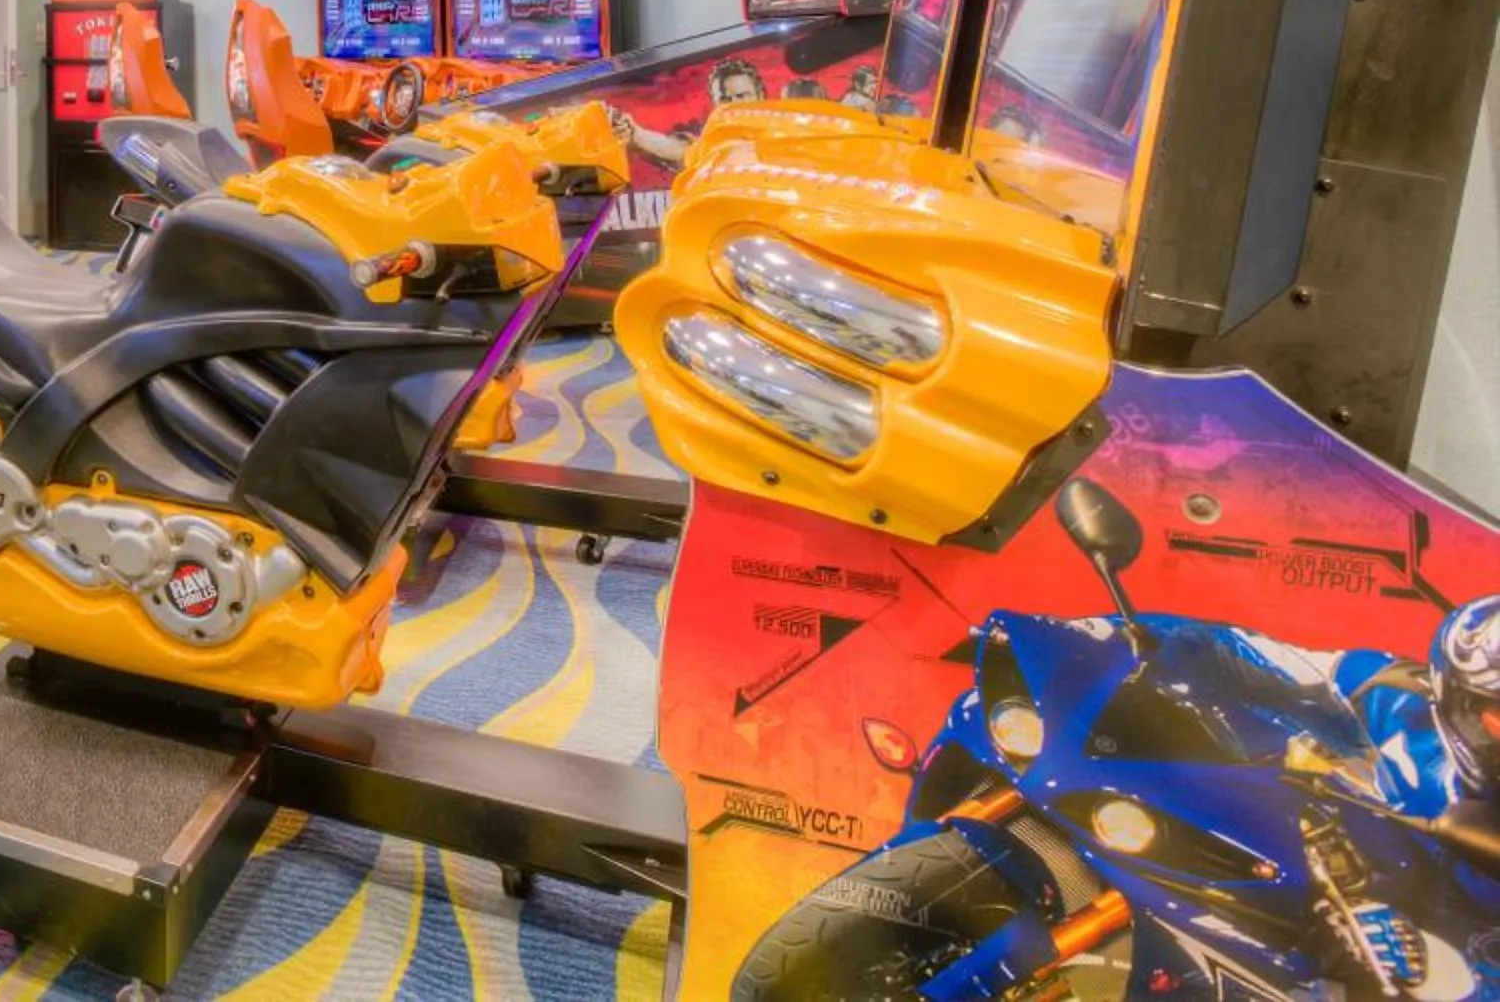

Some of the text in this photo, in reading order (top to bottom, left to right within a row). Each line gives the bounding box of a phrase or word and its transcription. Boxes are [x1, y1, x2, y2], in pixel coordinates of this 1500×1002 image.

[1321, 556, 1373, 575] BOOST
[169, 568, 211, 601] RAW
[1280, 567, 1376, 595] OUTPUT
[175, 585, 217, 610] THRILLS
[723, 798, 789, 823] CONTROL
[832, 878, 912, 907] BUSTION
